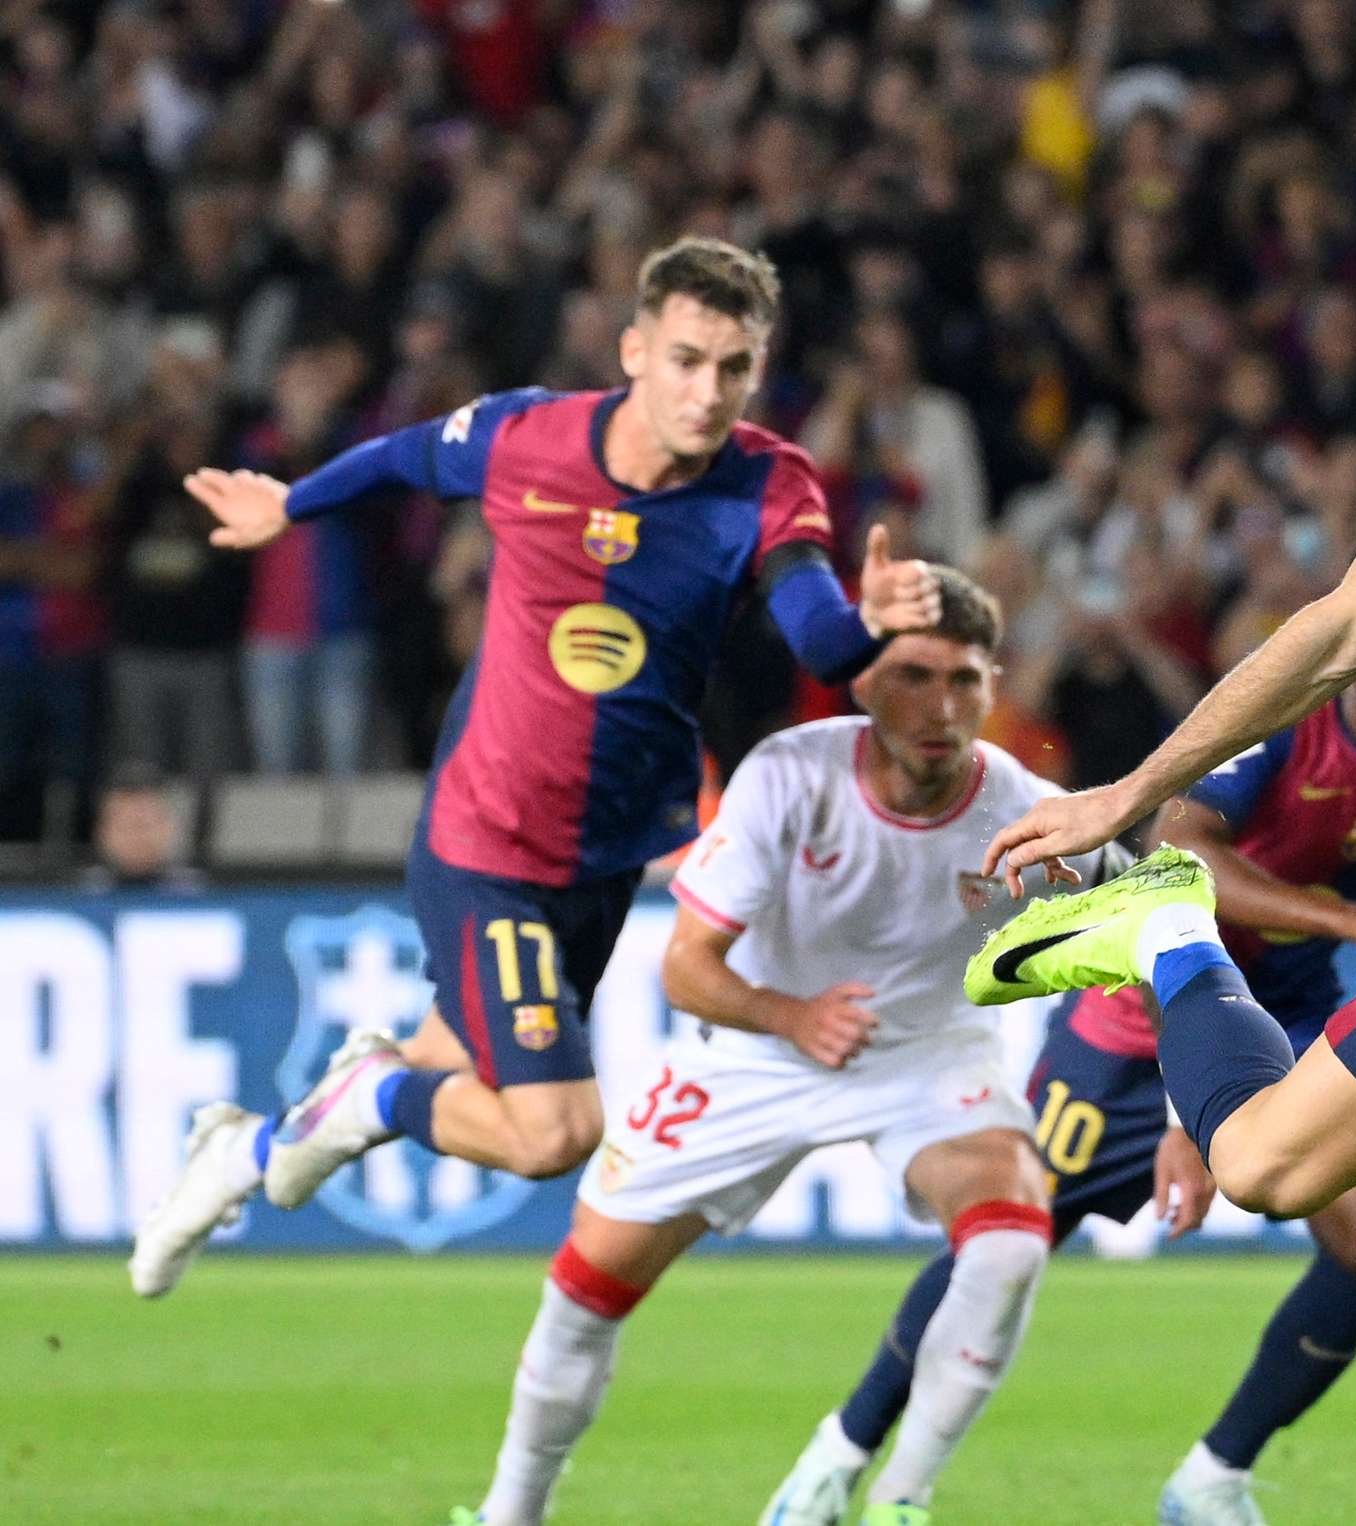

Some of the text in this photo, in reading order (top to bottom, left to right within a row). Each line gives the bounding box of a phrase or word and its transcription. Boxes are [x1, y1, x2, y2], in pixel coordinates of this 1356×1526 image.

[485, 918, 559, 1002] 17
[627, 1068, 711, 1150] 32
[1035, 1079, 1105, 1175] 10
